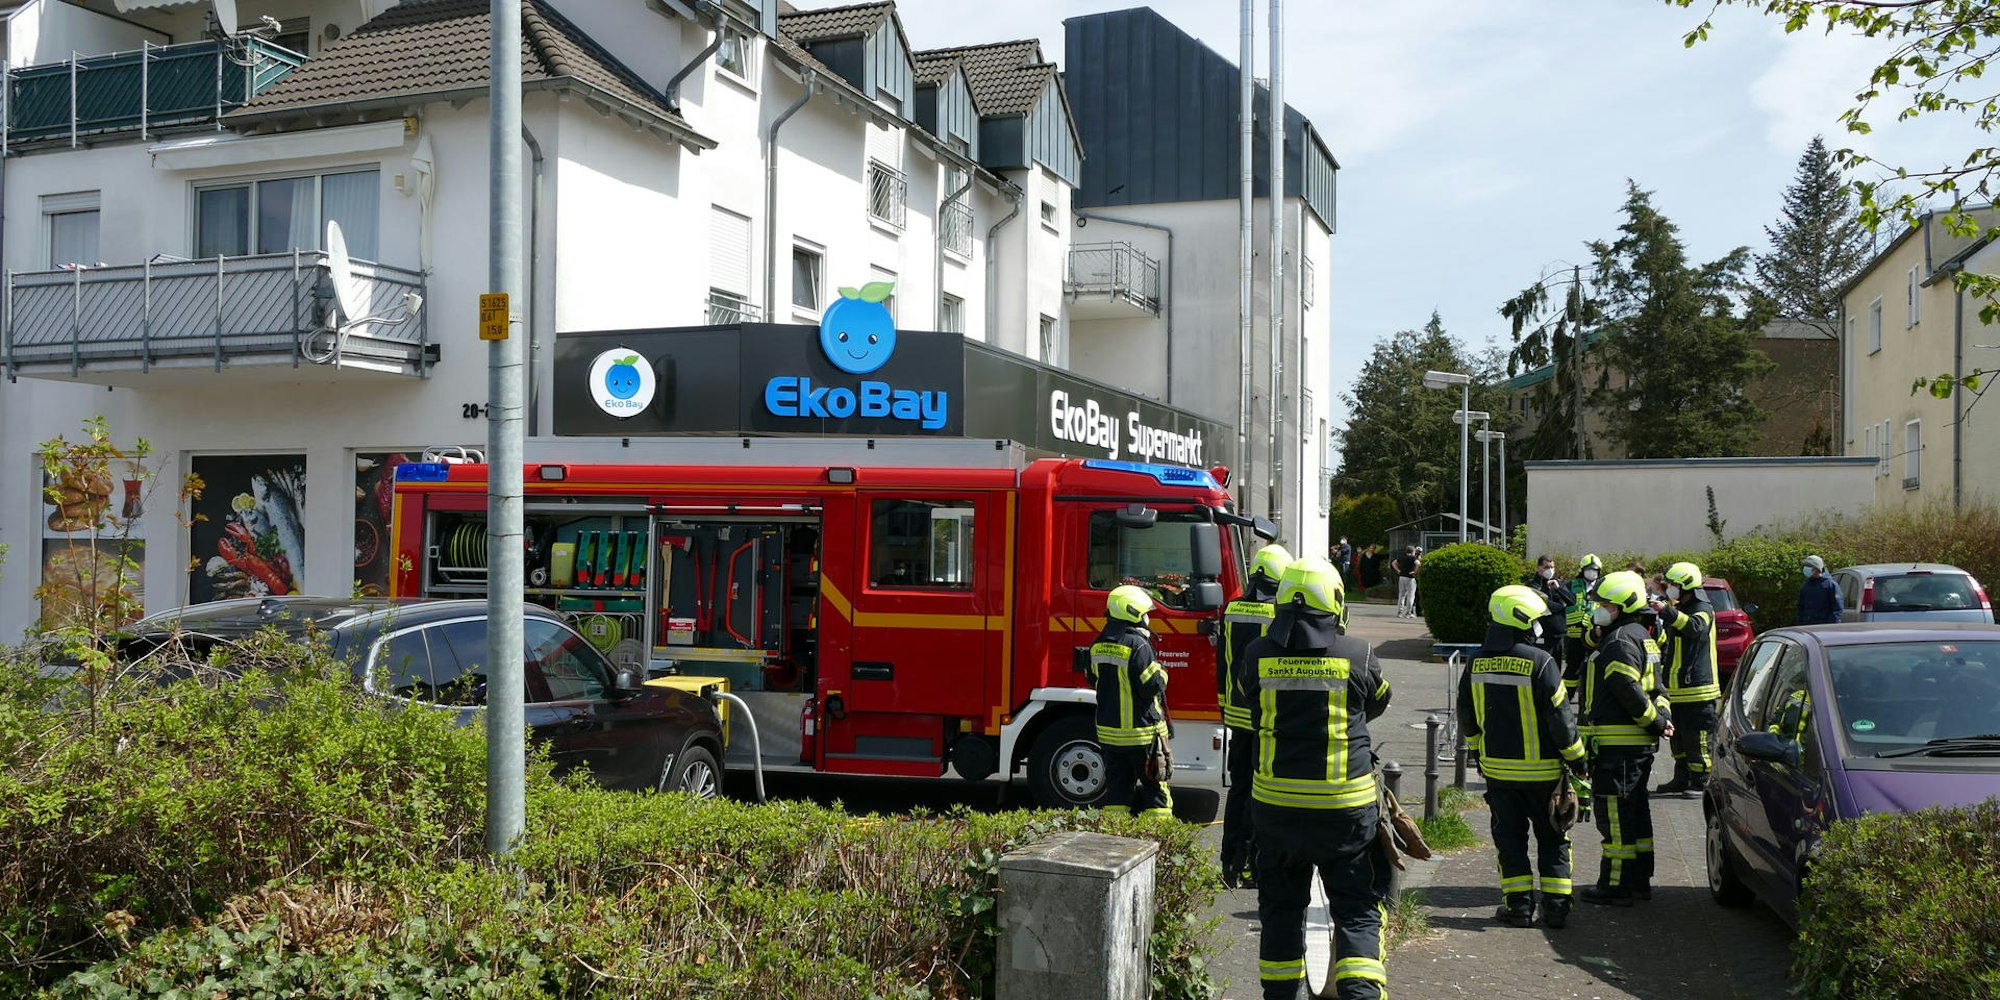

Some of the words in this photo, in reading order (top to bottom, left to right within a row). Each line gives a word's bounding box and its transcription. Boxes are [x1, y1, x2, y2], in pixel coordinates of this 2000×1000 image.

[1051, 389, 1120, 460] EkoBay
[1127, 411, 1203, 467] Supermarkt
[1158, 650, 1189, 658] Feuerwehr
[1277, 657, 1327, 666] Feuerwehr
[1474, 658, 1531, 674] FEUERWEHR
[1267, 667, 1294, 676] Sankt
[1296, 667, 1338, 677] Augustin
